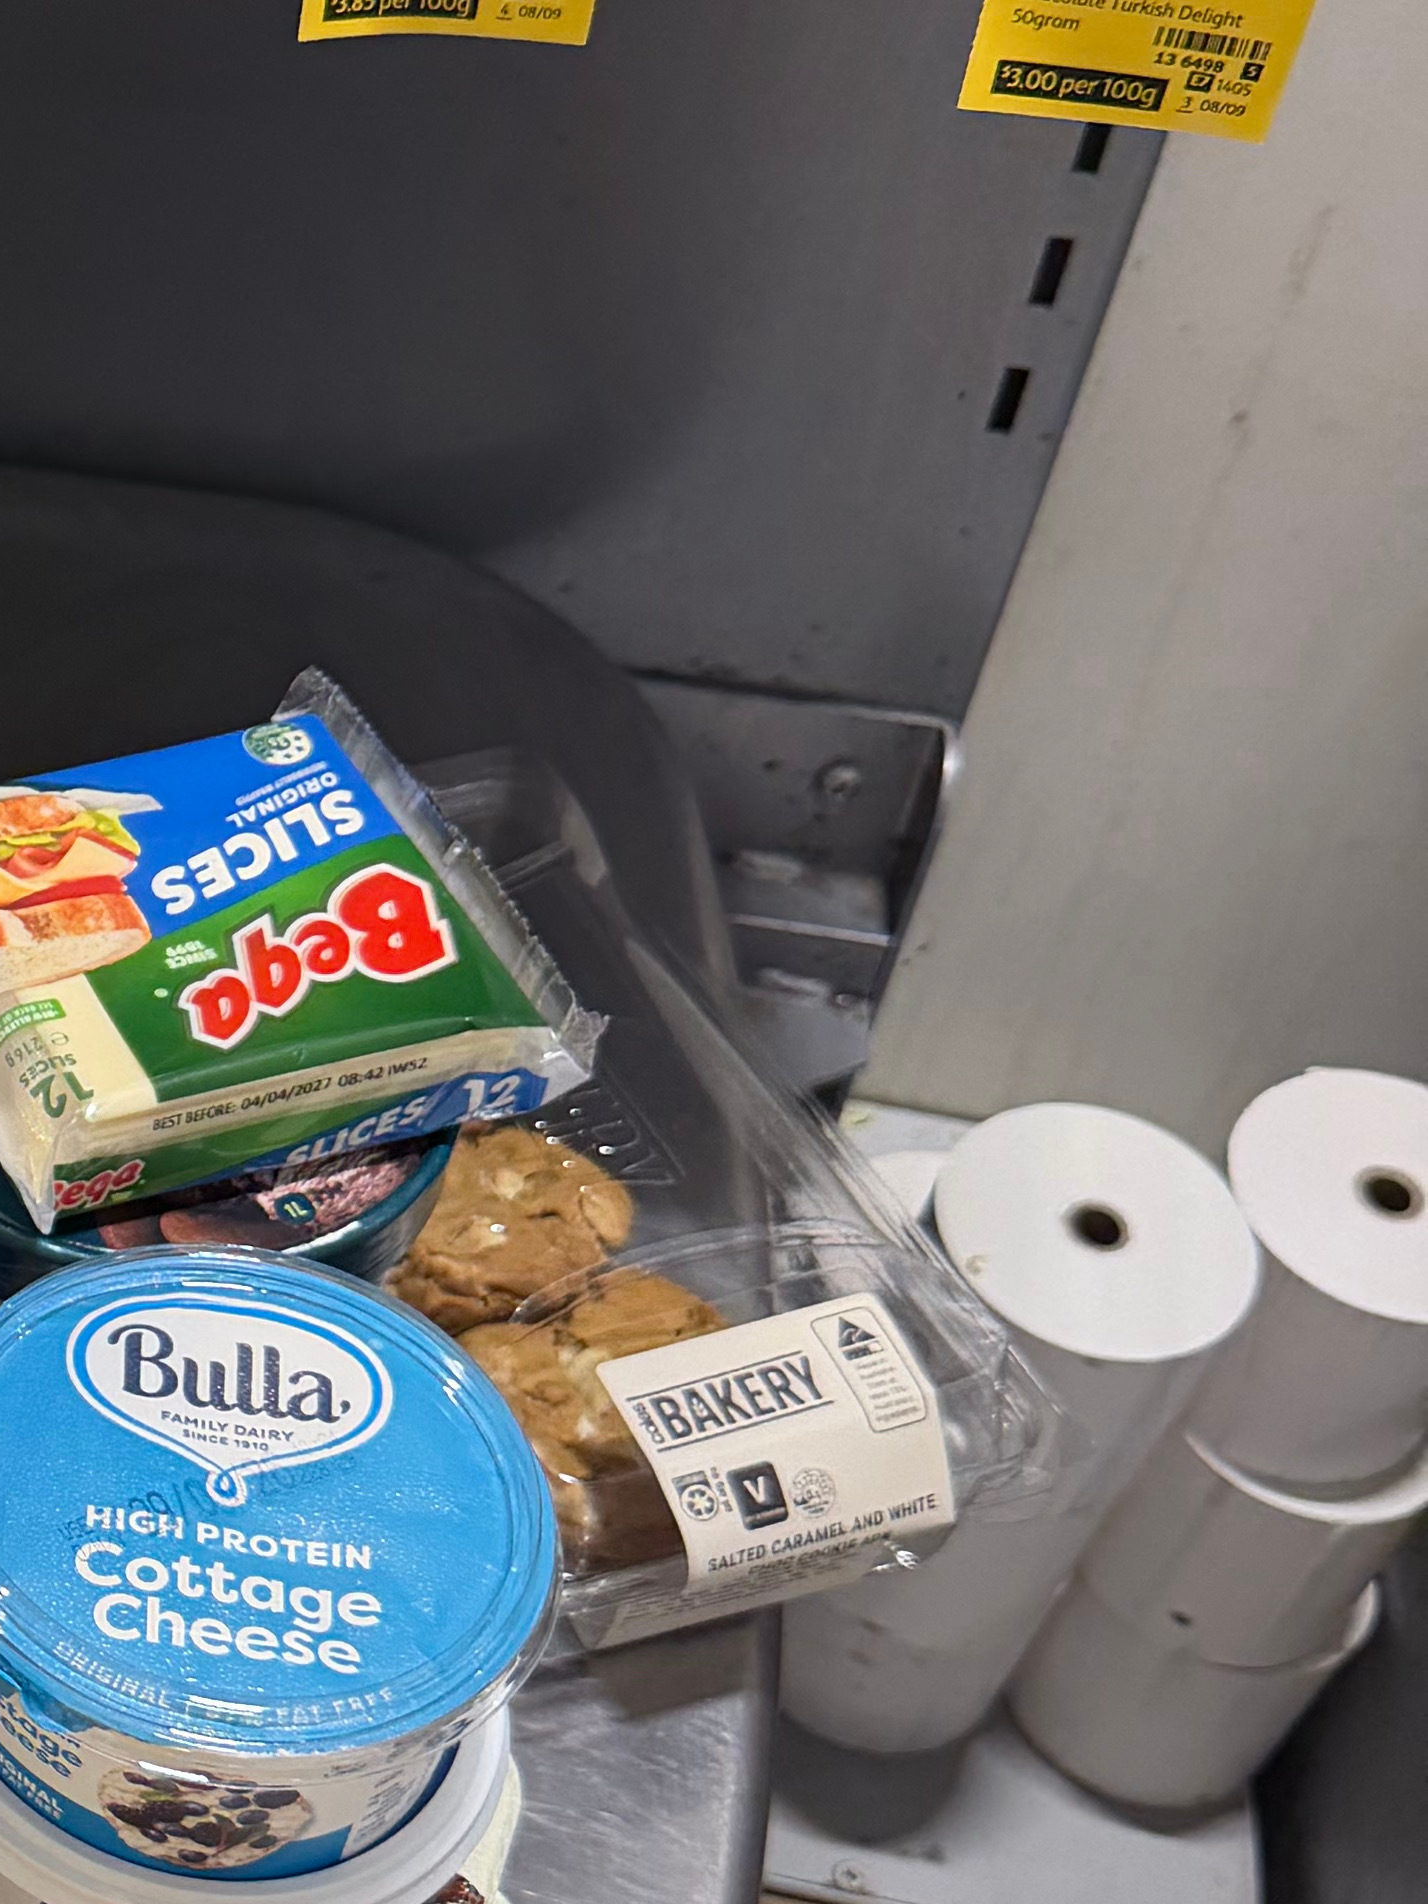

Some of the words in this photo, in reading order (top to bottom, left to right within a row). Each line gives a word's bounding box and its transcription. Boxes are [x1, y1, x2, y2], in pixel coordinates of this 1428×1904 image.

[1011, 9, 1080, 32] 50gram
[1178, 4, 1245, 30] Delight
[225, 771, 339, 829] ORIGINAL
[150, 790, 365, 916] SLICES
[184, 865, 455, 1047] Bega
[152, 1114, 182, 1131] BEST
[185, 1101, 237, 1125] BEFORE:
[240, 1076, 333, 1110] 04/04/2027
[338, 1065, 384, 1087] 08:42
[107, 1323, 344, 1423] Bulla
[648, 1355, 823, 1441] BAKERY
[161, 1410, 228, 1434] FAMILY
[234, 1423, 295, 1442] DAIRY
[86, 1504, 184, 1540] HIGH
[196, 1522, 372, 1570] PROTEIN
[707, 1543, 766, 1572] SALTED
[771, 1521, 846, 1555] CARAMEL
[851, 1509, 884, 1533] AND
[889, 1493, 938, 1520] WHITE
[74, 1541, 382, 1635] Cottage
[93, 1593, 361, 1674] Cheese
